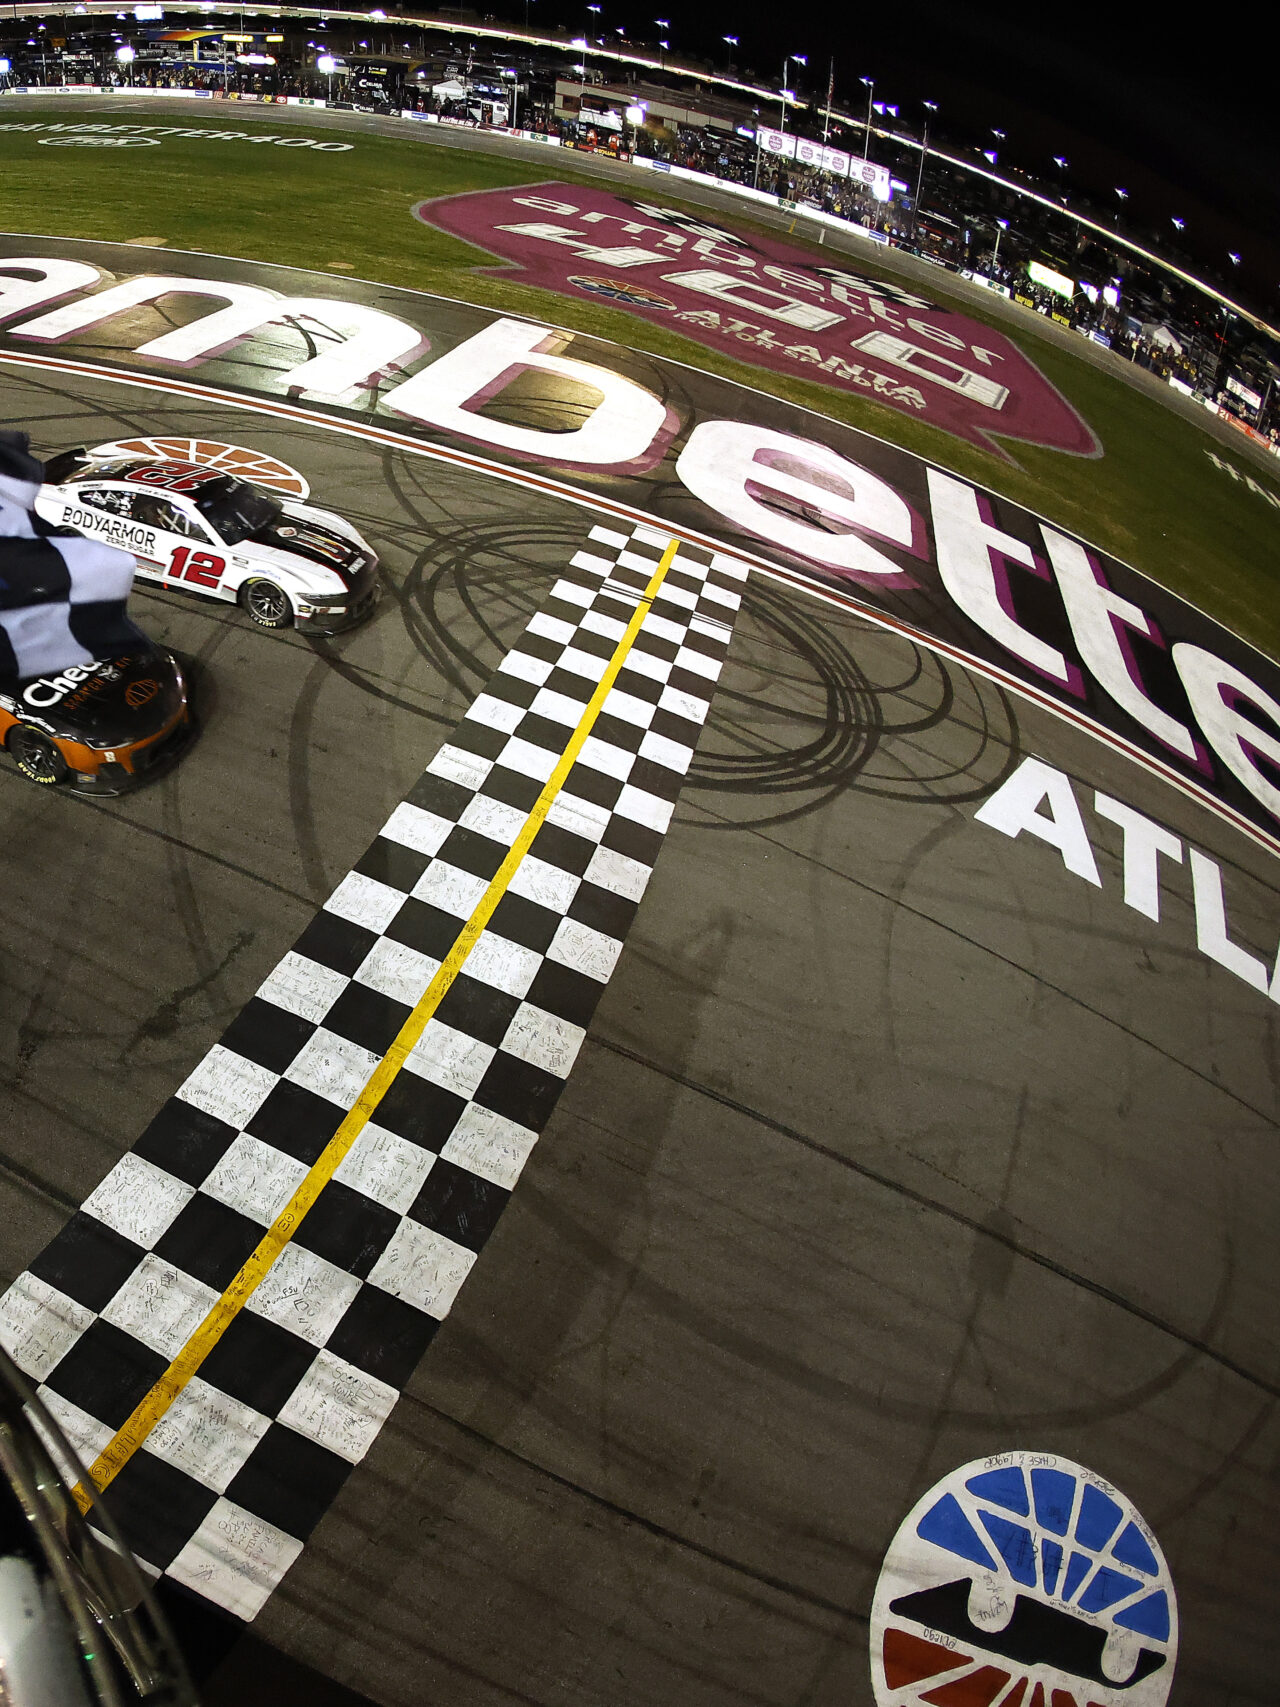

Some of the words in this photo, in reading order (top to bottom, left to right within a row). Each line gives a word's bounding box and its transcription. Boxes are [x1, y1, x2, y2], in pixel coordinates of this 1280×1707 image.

[493, 222, 1010, 411] 400
[512, 195, 1005, 366] ambetter
[673, 313, 787, 352] MOTOR
[782, 344, 928, 409] SPEEDWAY
[682, 308, 928, 404] ATLANTA
[62, 507, 156, 549] BODYARMOR
[106, 536, 126, 548] ZERO
[128, 542, 155, 556] SUGAR
[168, 546, 226, 589] 12
[974, 756, 1280, 1006] ATL
